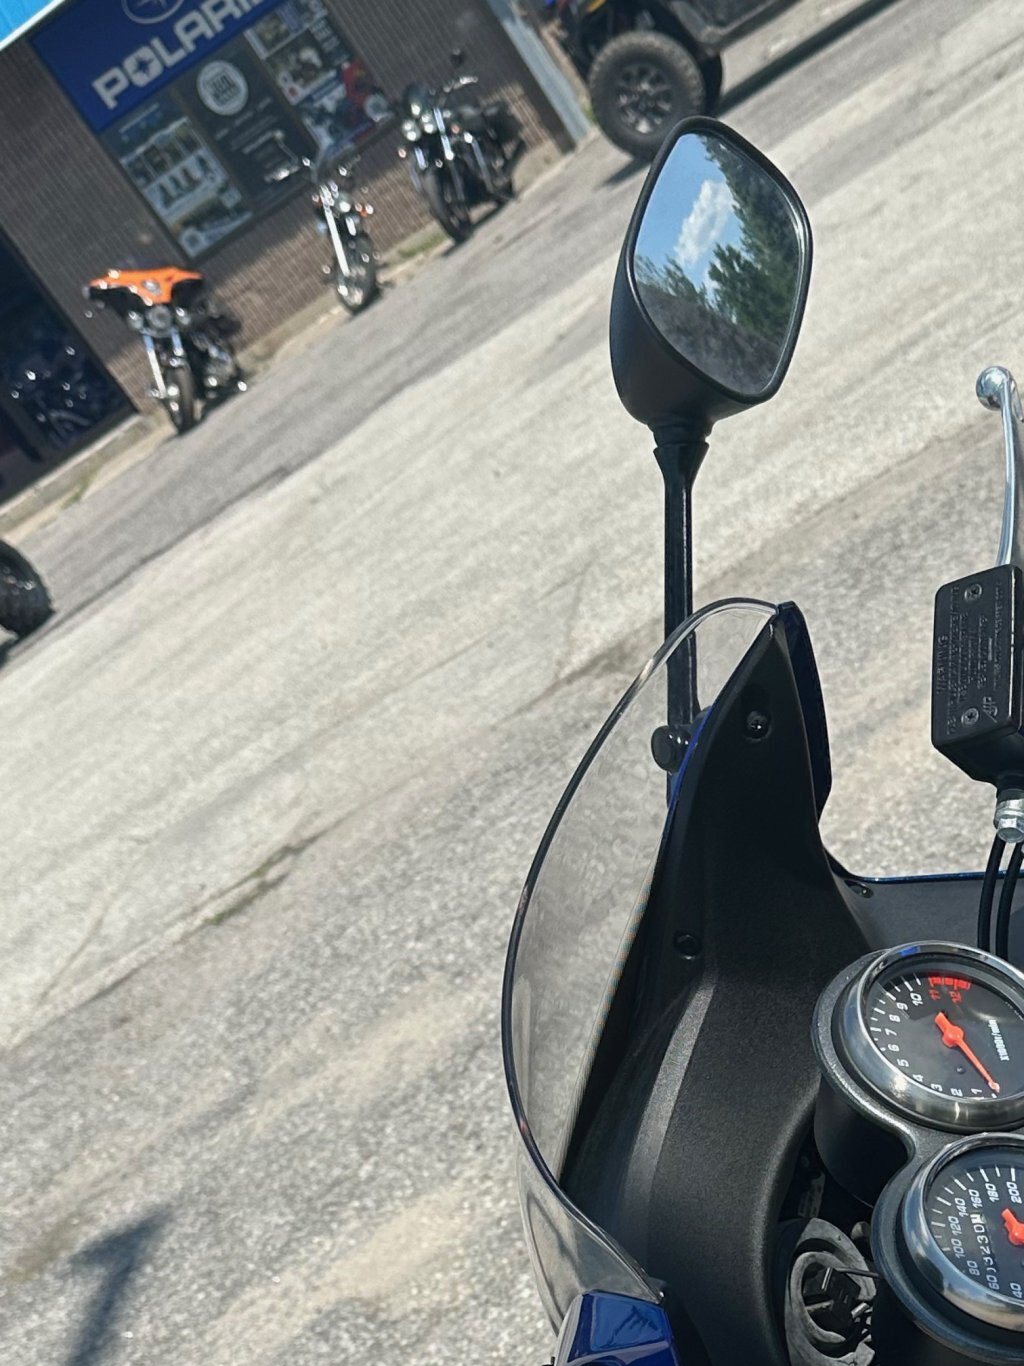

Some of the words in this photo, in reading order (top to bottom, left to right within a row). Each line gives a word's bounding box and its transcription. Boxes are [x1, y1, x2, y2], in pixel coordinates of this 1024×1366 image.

[91, 0, 264, 110] POLAR
[909, 992, 923, 1006] 10
[930, 989, 941, 1000] 11
[896, 1002, 908, 1011] 9
[888, 1014, 901, 1022] 8
[885, 1028, 897, 1036] 7
[888, 1043, 900, 1052] 6
[898, 1058, 909, 1068] 5
[912, 1073, 924, 1082] 4
[931, 1083, 943, 1092] 3
[951, 1088, 963, 1097] 2
[968, 1189, 983, 1209] 160
[985, 1183, 999, 1203] 180
[1006, 1181, 1022, 1204] 200
[955, 1197, 967, 1218] 140
[948, 1216, 962, 1237] 120
[950, 1238, 966, 1258] 100
[966, 1260, 980, 1276] 80
[986, 1274, 1000, 1290] 60
[1010, 1282, 1023, 1298] 40
